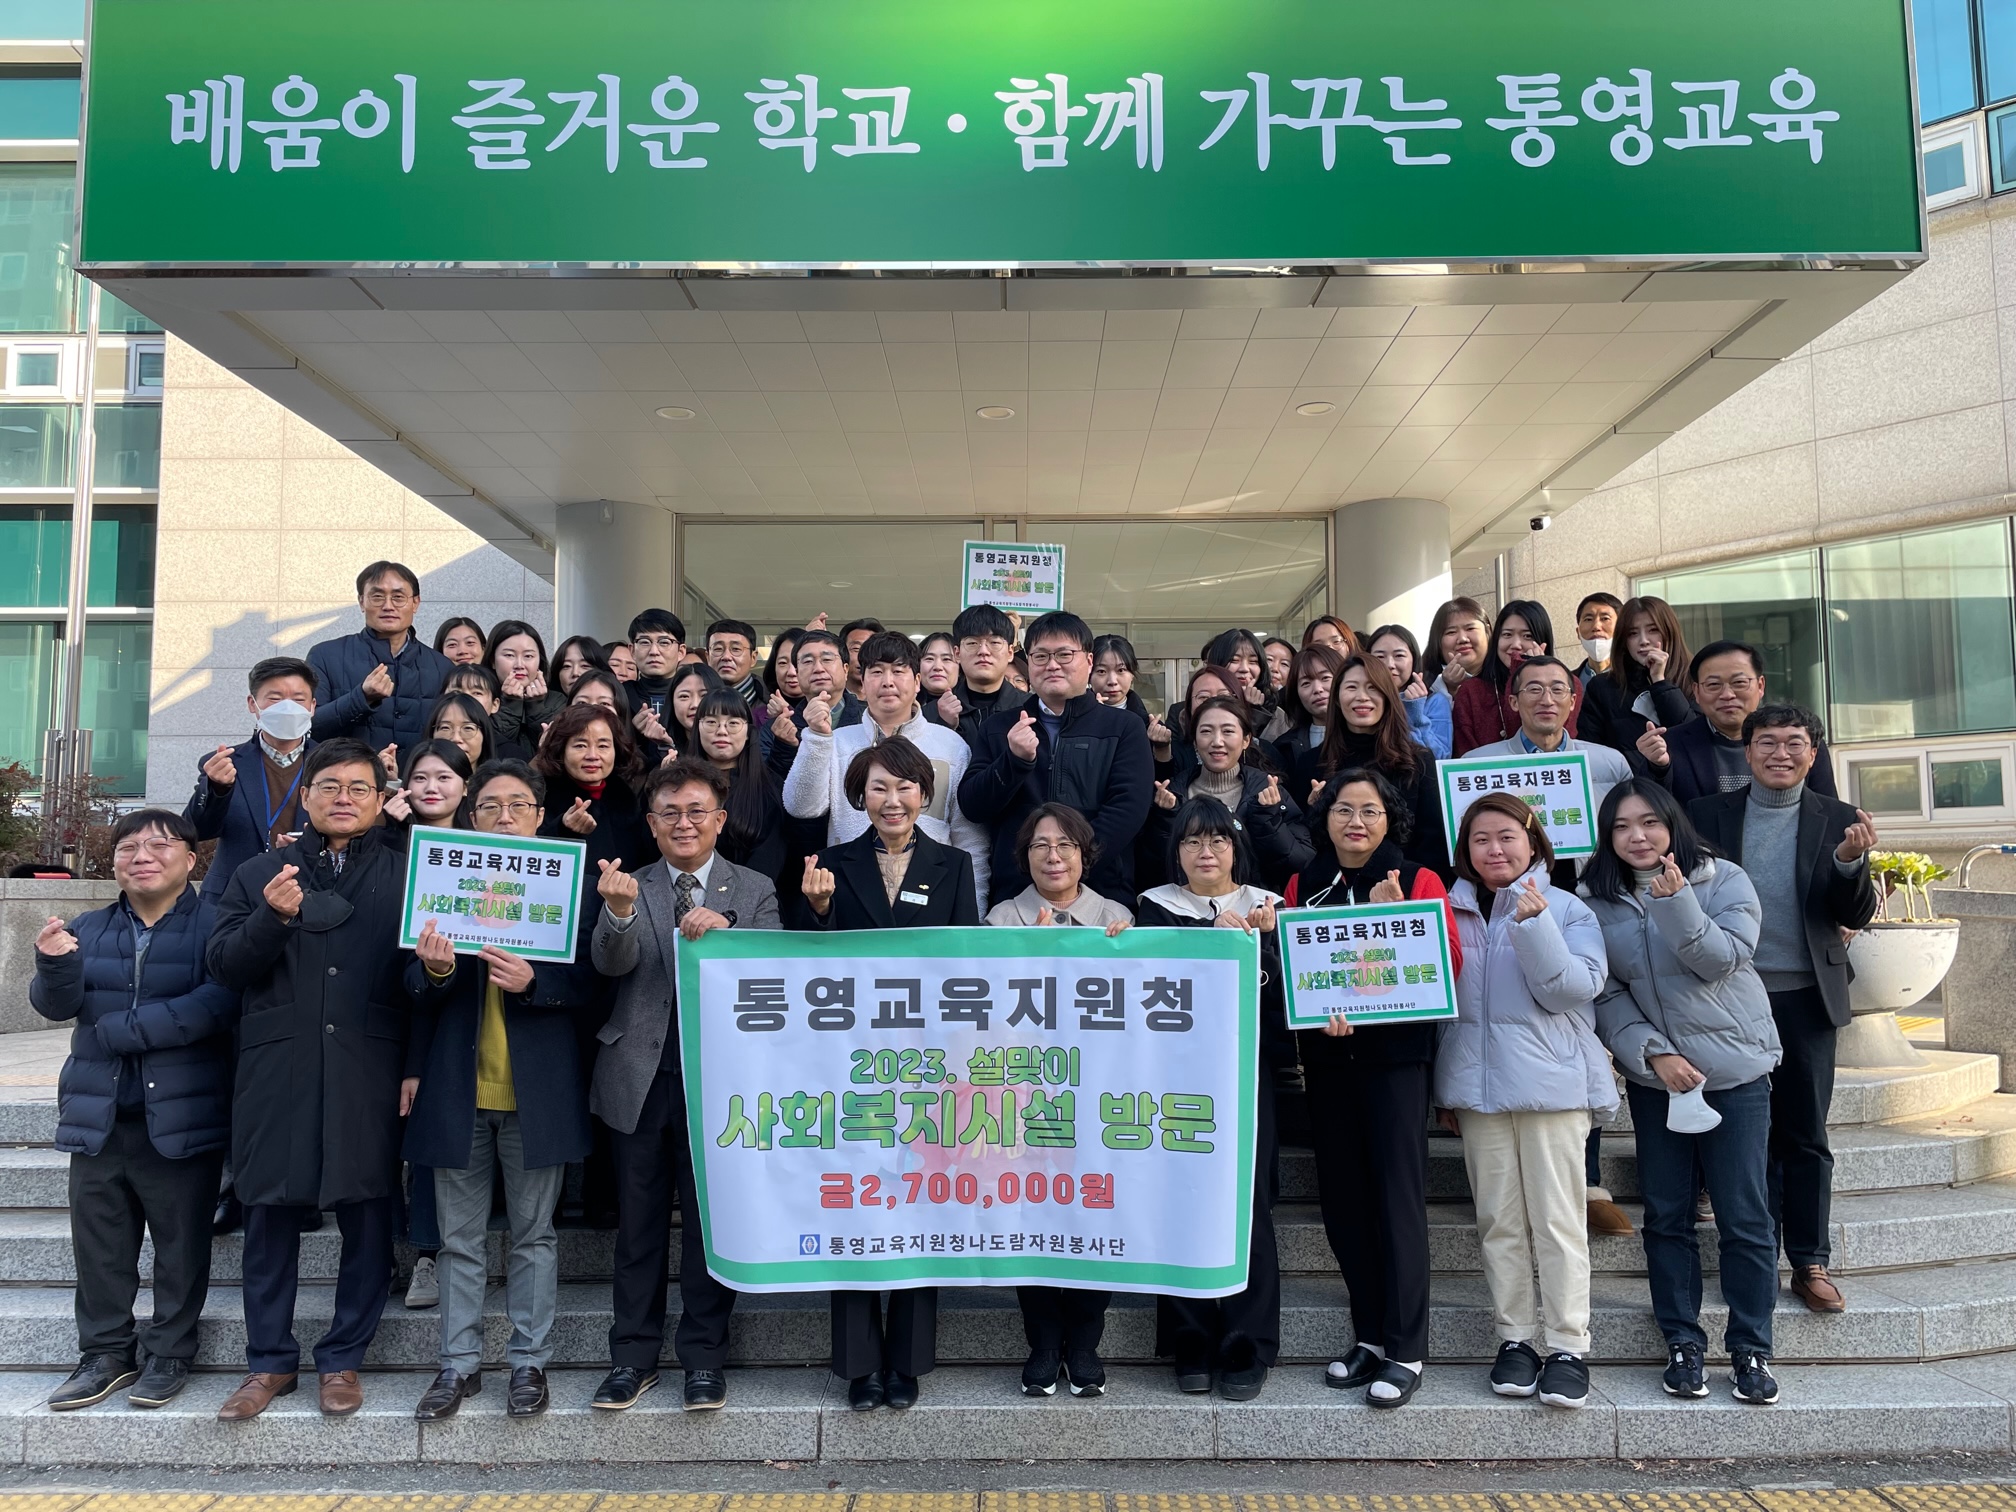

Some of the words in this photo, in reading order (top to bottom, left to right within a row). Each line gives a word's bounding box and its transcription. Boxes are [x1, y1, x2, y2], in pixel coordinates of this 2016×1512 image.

[165, 74, 418, 174] 배움이
[451, 74, 721, 174] 즐거운
[745, 74, 921, 174] 학교
[994, 72, 1165, 172] 함께
[1199, 72, 1463, 171] 가꾸는
[1485, 67, 1841, 168] 통영교육
[974, 552, 1052, 567] 통영교육지원청
[1457, 768, 1573, 793] 통영교육지원청
[1551, 807, 1583, 826] 방문
[427, 847, 562, 877] 통영교육지원청
[457, 877, 489, 893] 2023.
[491, 880, 527, 897] 설맞이
[417, 893, 522, 921] 사회복지시설
[528, 903, 564, 925] 방문
[1295, 918, 1427, 945] 통영교육지원청
[1330, 950, 1361, 964] 2023.
[1363, 947, 1397, 962] 설맞이
[1296, 965, 1399, 991] 사회복지시설
[1402, 963, 1438, 985] 방문
[732, 975, 1195, 1032] 통영교육지원청
[850, 1046, 957, 1085] 2023.
[967, 1045, 1081, 1087] 설맞이
[716, 1090, 1077, 1152] 사회복지시설
[1099, 1091, 1216, 1154] 방문
[819, 1172, 1116, 1210] 금2,700,000원
[828, 1232, 1126, 1257] 통영교육지원청나도람자원봉사단
